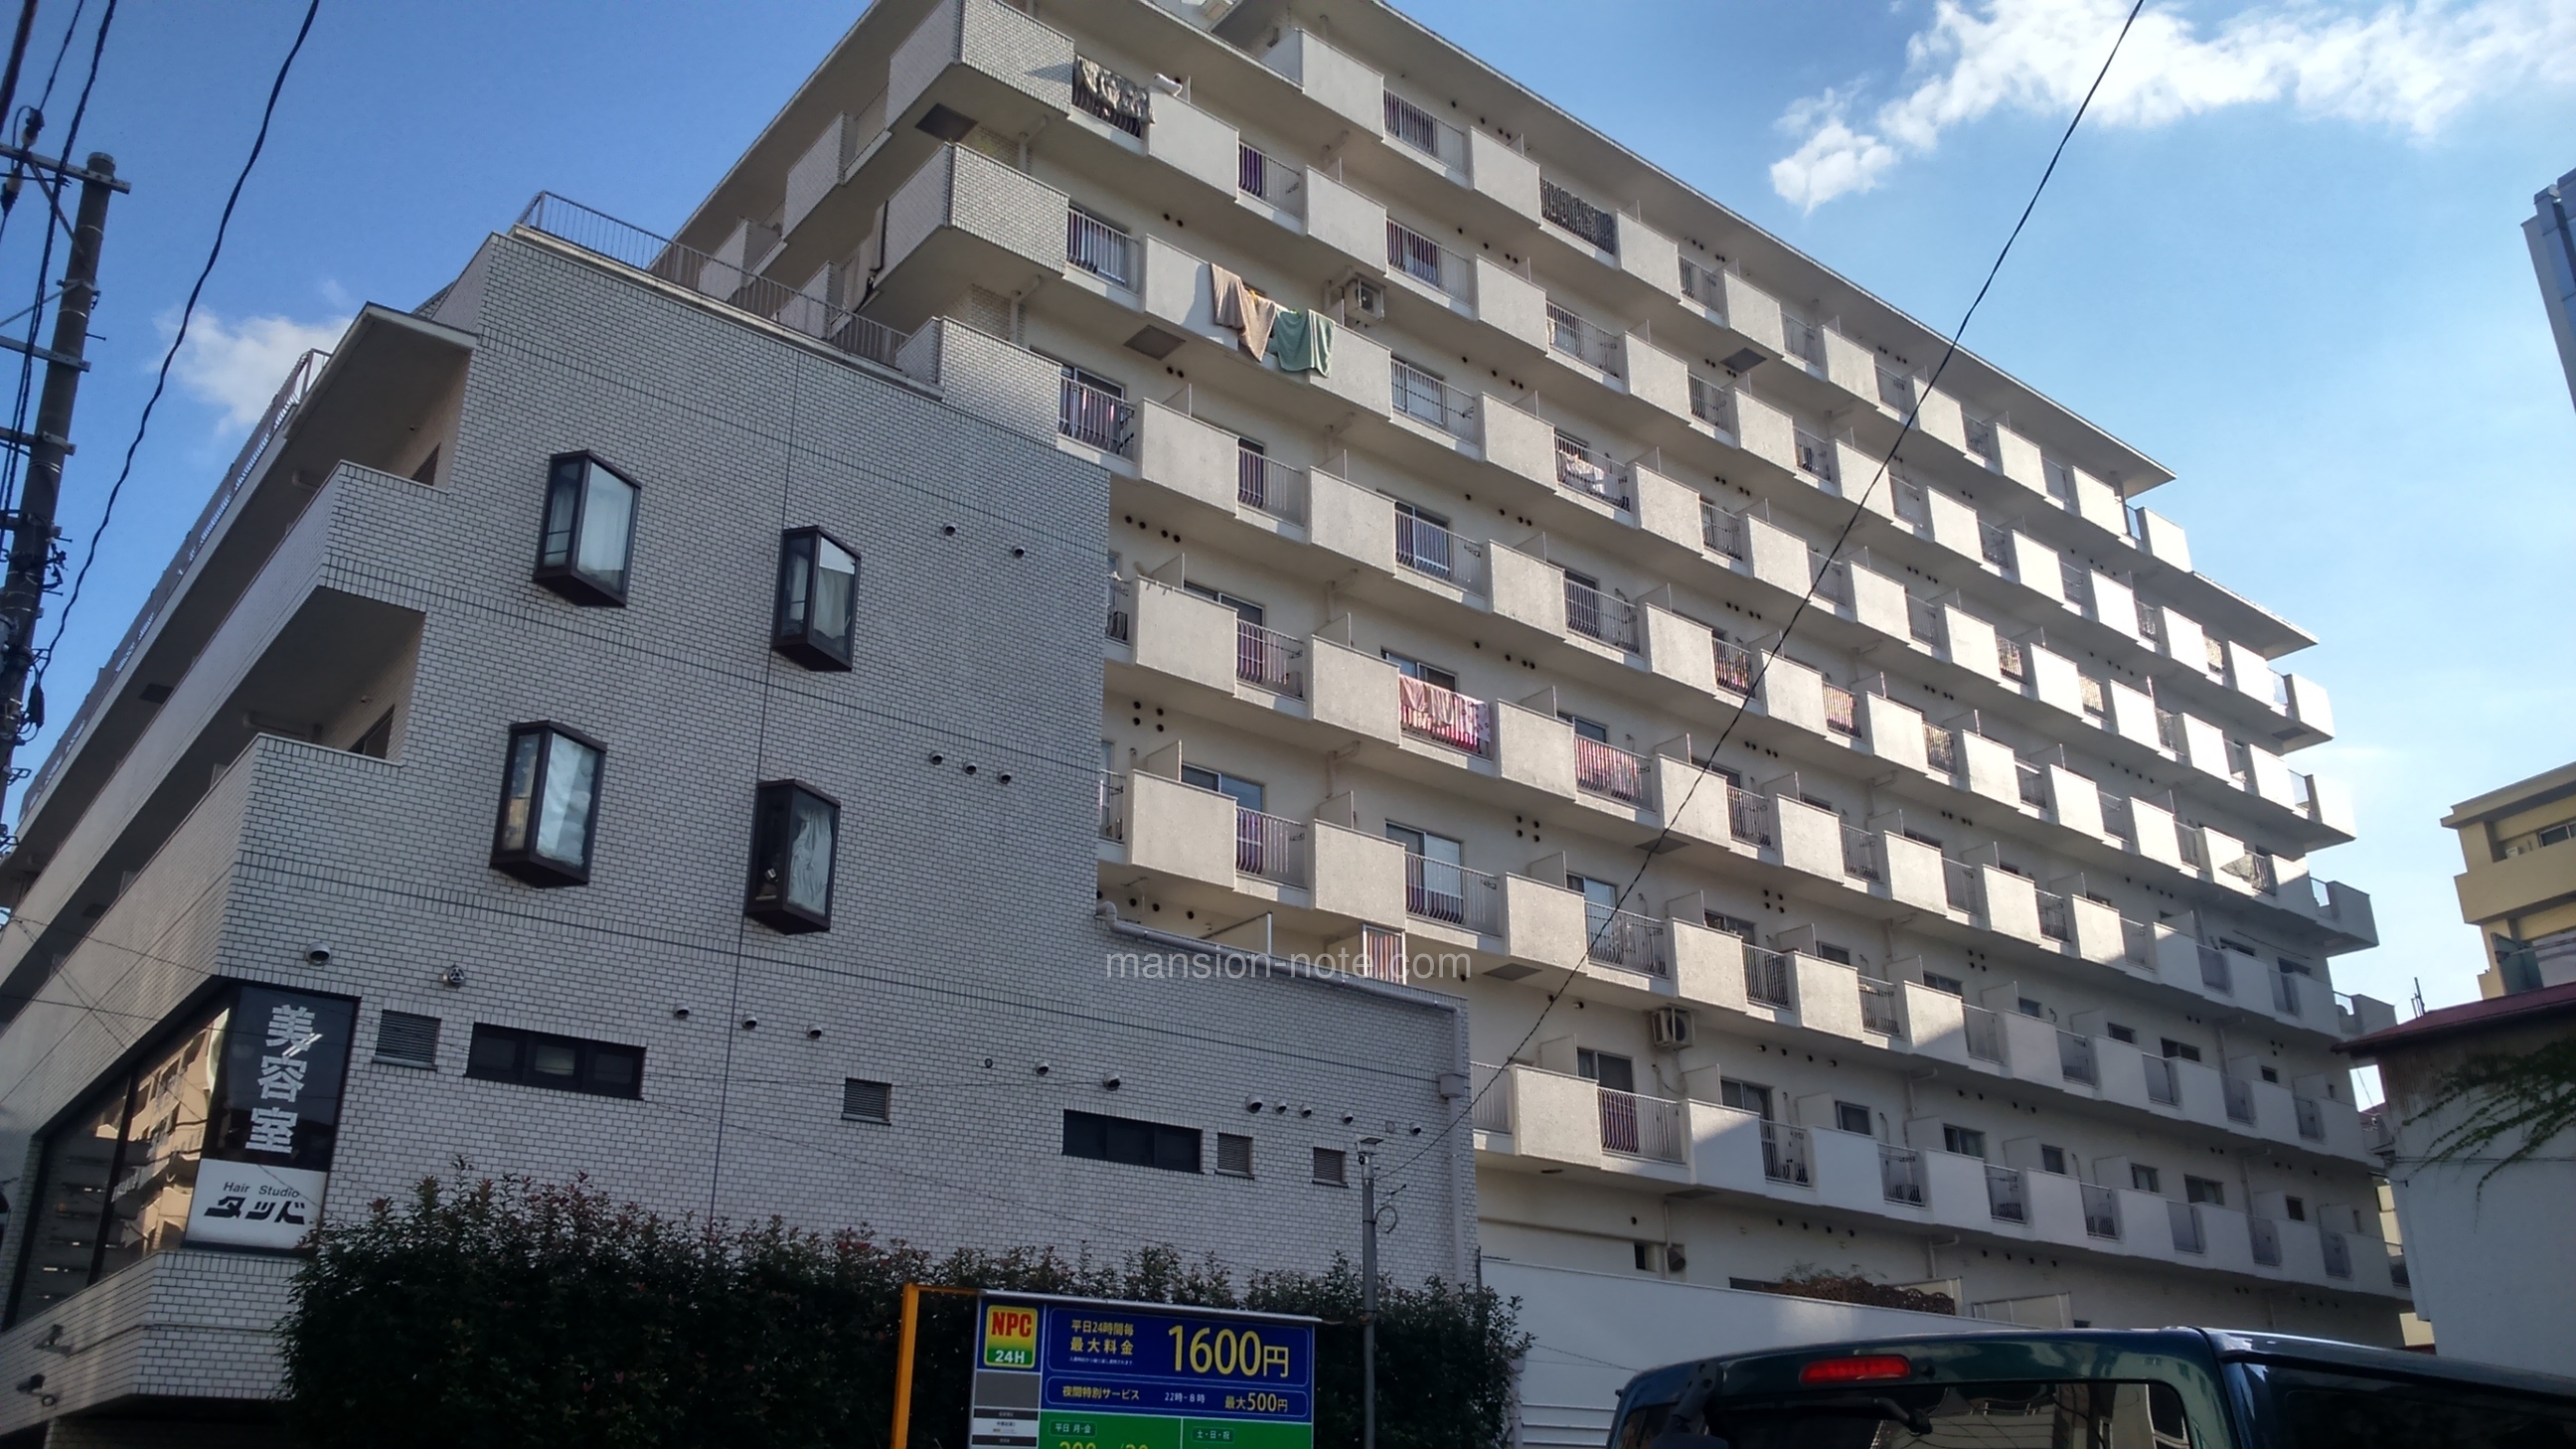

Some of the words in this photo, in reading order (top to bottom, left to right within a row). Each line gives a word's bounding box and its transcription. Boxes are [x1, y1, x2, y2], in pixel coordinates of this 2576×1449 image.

[245, 1004, 317, 1154] 美容室
[223, 1182, 250, 1194] Hair
[258, 1185, 300, 1199] Studio
[992, 1312, 1032, 1338] NPC
[1071, 1319, 1134, 1337] 平日24時間毎
[1070, 1336, 1134, 1356] 最大料金
[1168, 1325, 1289, 1378] 1600円
[995, 1350, 1026, 1365] 24H
[1062, 1385, 1140, 1400] 夜間特別サービス
[1224, 1392, 1288, 1412] 最大500円
